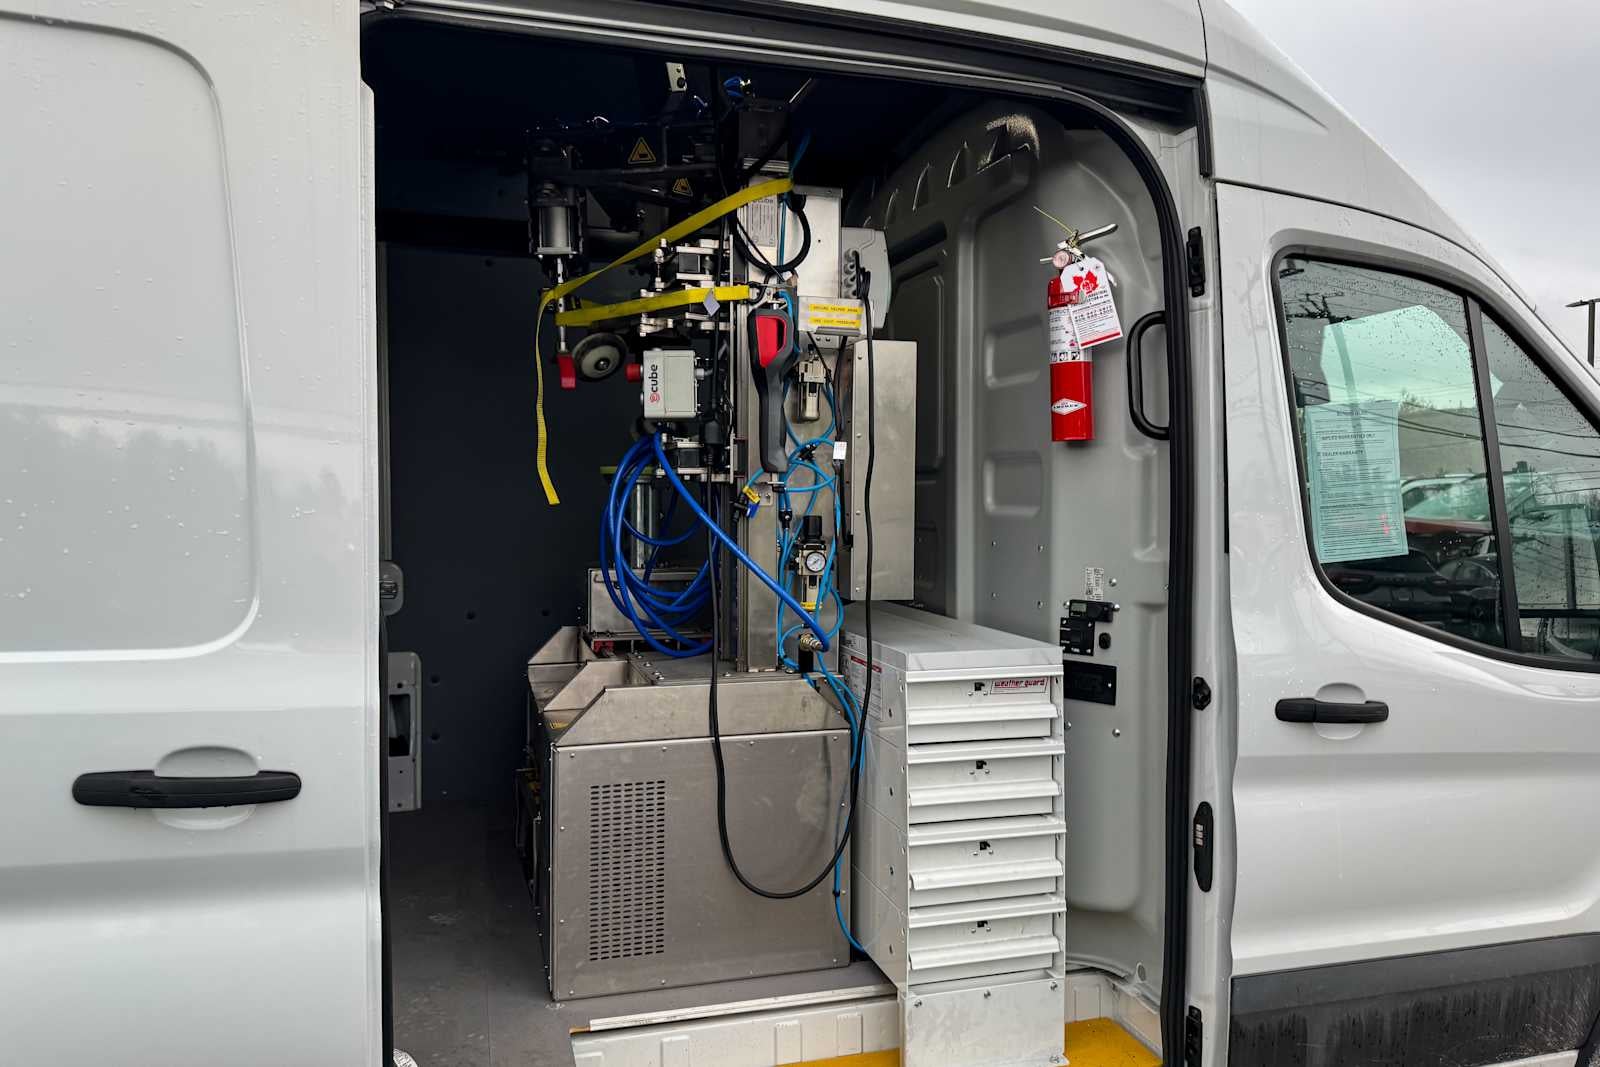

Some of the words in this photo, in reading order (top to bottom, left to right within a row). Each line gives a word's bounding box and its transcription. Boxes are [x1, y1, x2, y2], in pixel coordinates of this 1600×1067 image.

[648, 364, 658, 393] cube
[994, 679, 1024, 687] weather
[1024, 678, 1045, 688] guard
